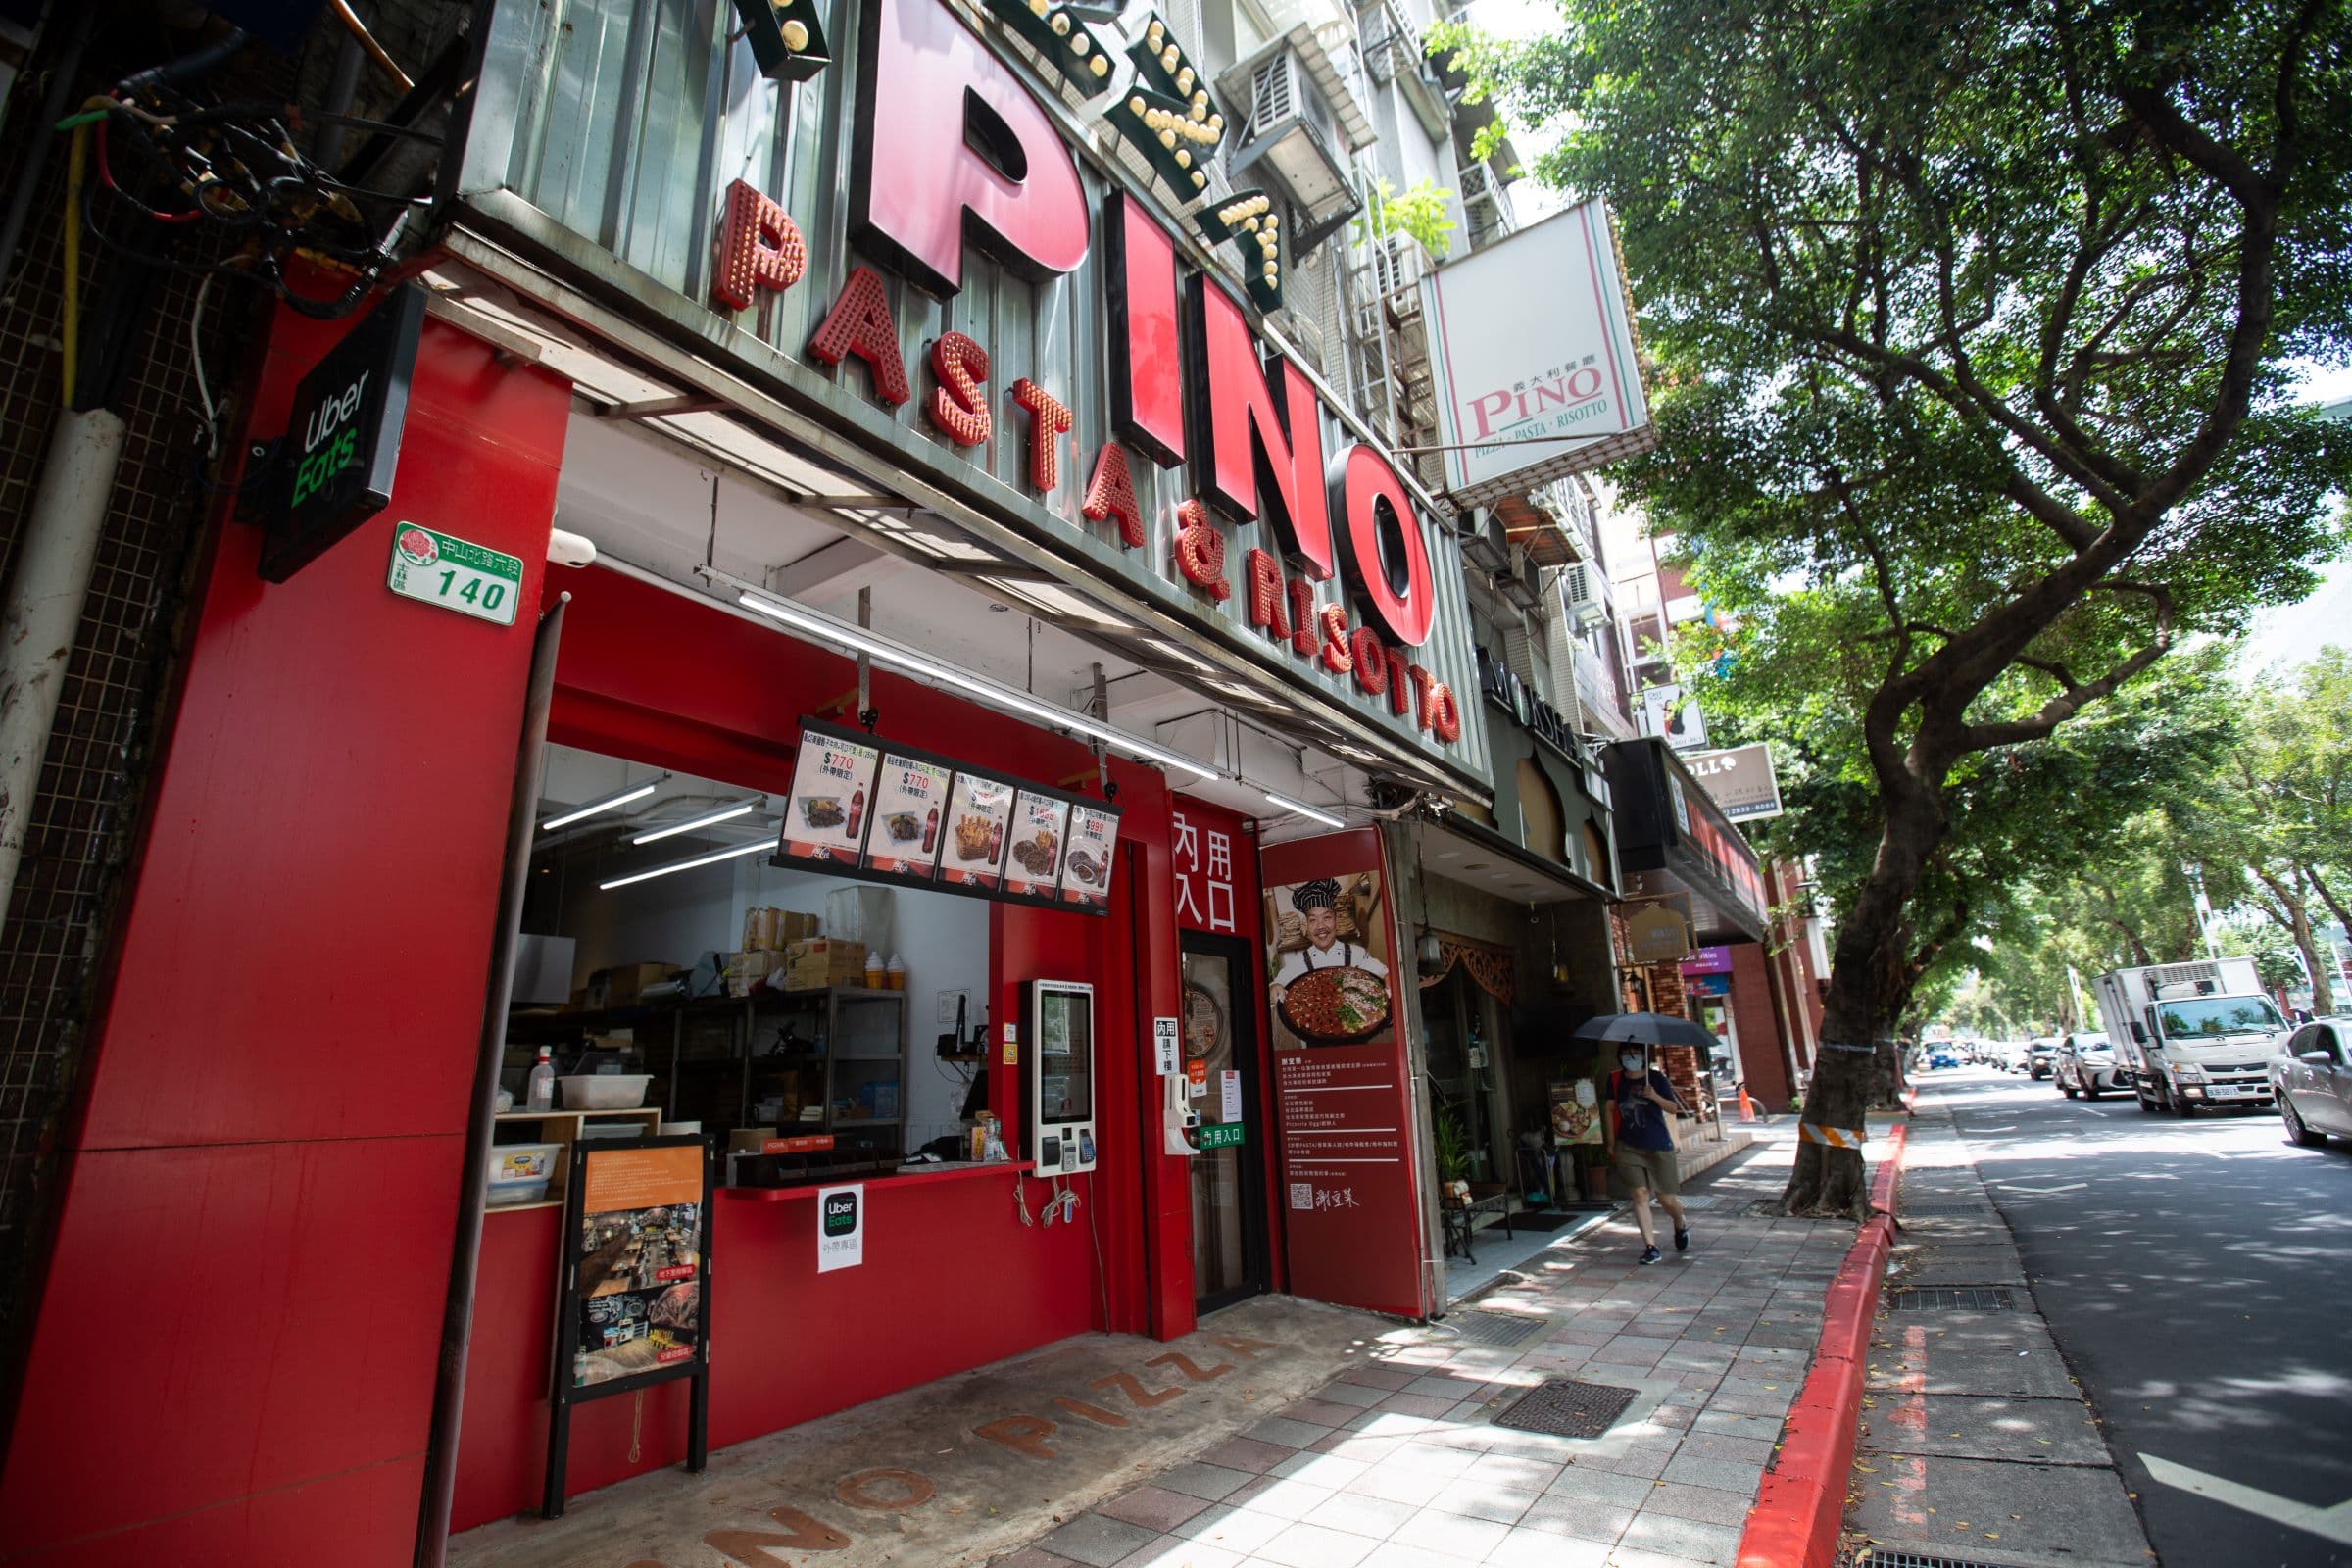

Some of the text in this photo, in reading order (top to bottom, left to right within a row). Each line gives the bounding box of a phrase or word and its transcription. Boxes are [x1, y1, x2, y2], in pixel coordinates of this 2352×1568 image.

[847, 0, 1435, 649] PINO
[305, 368, 370, 454] Uber
[1466, 367, 1602, 442] PINO
[1514, 421, 1547, 441] PASTA
[1557, 398, 1608, 429] RISOTTO
[291, 427, 358, 510] Eats
[713, 178, 1460, 743] PASTA & RISOTTO
[441, 539, 520, 579] 中山北路六段
[438, 569, 506, 611] 140
[823, 751, 854, 770] $770
[903, 772, 930, 789] $770
[828, 1202, 853, 1214] Uber
[828, 1214, 853, 1227] Eats
[974, 1335, 1277, 1459] PIZZA
